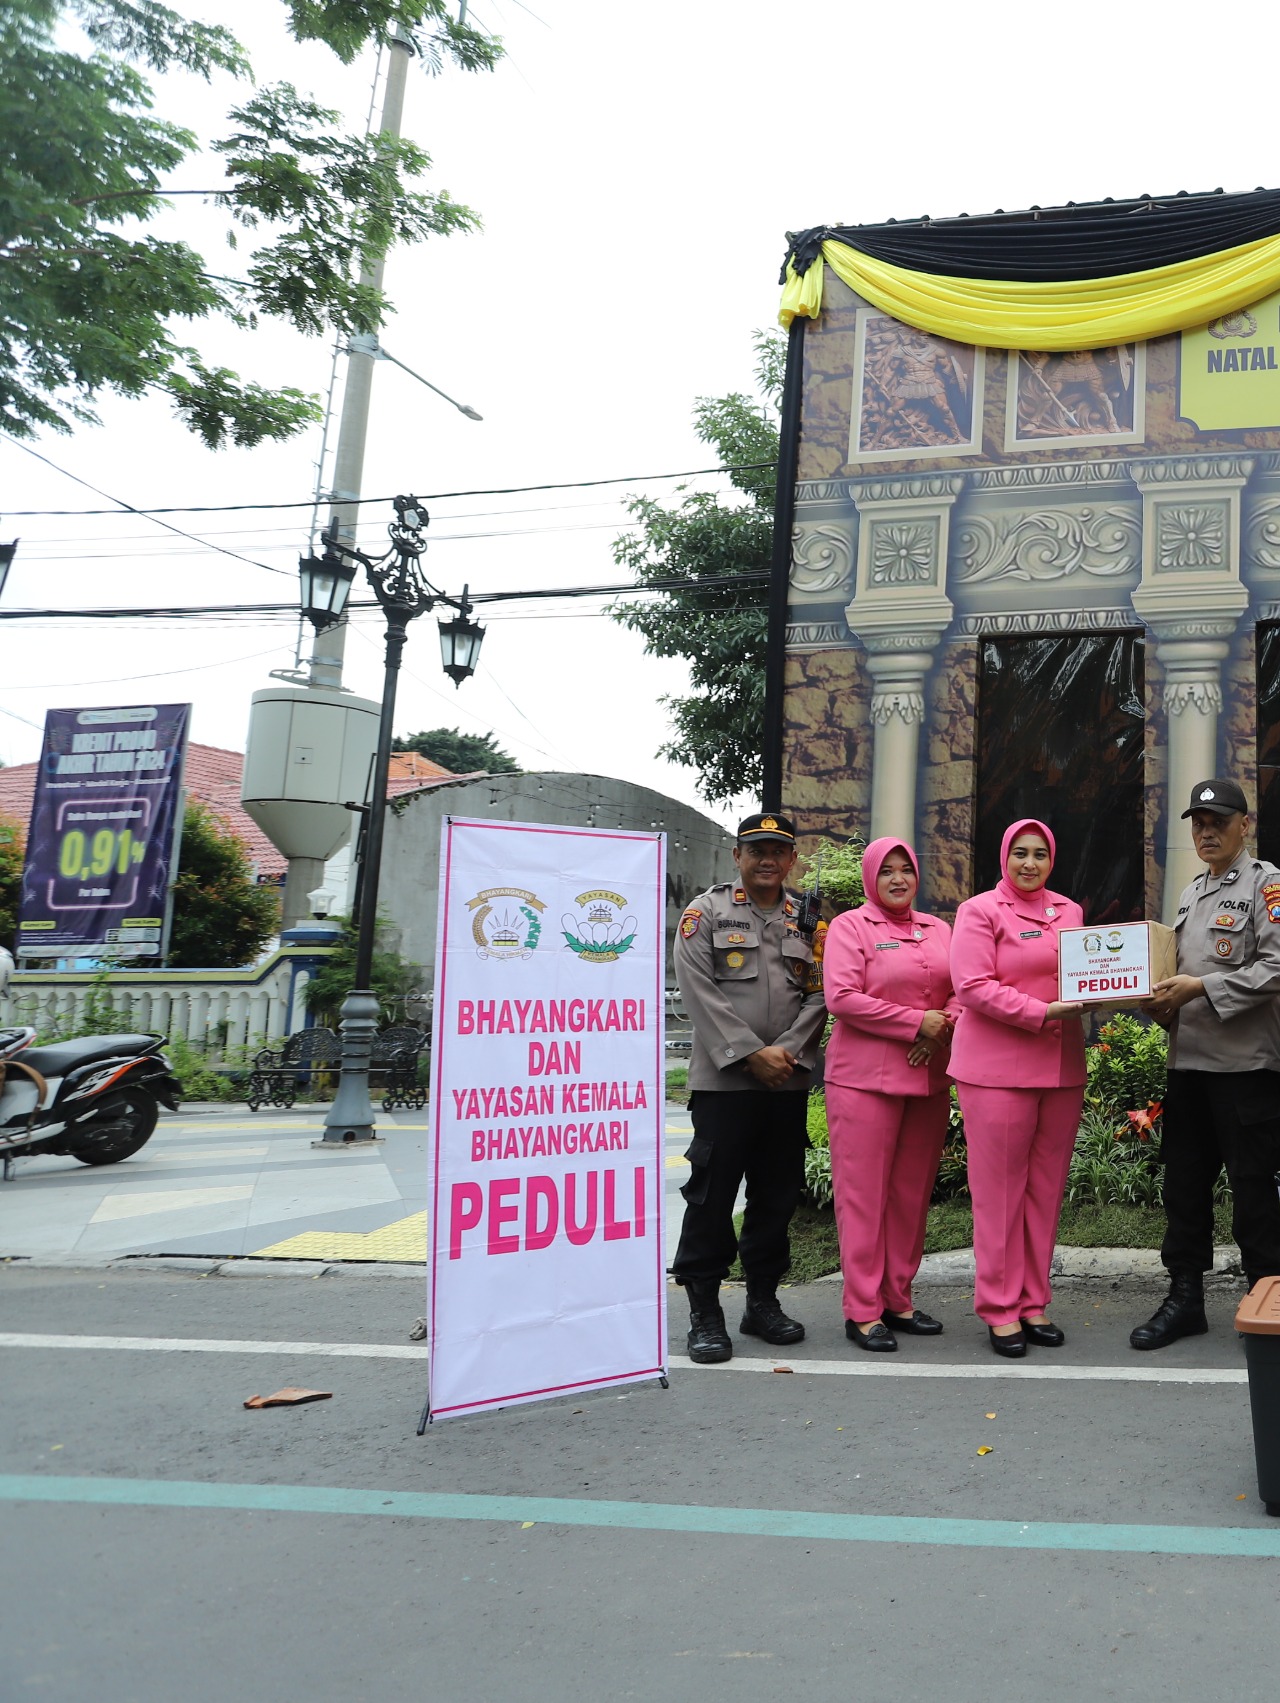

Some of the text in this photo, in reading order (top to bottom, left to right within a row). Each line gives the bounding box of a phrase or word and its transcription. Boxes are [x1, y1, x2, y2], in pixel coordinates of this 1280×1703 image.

[1207, 346, 1278, 373] NATAL
[56, 750, 165, 774] AKHIR TAHUN 2024
[481, 888, 532, 900] BHAYANGKARI
[582, 892, 621, 903] YAYASAN
[1218, 900, 1250, 913] POLRI
[1110, 965, 1144, 974] BHAYANGKARI
[1078, 975, 1138, 993] PEDULI
[457, 998, 645, 1035] BHAYANGKARI
[528, 1040, 581, 1076] DAN
[452, 1080, 647, 1120] YAYASAN KEMALA
[471, 1120, 629, 1162] BHAYANGKARI
[449, 1166, 645, 1260] PEDULI
